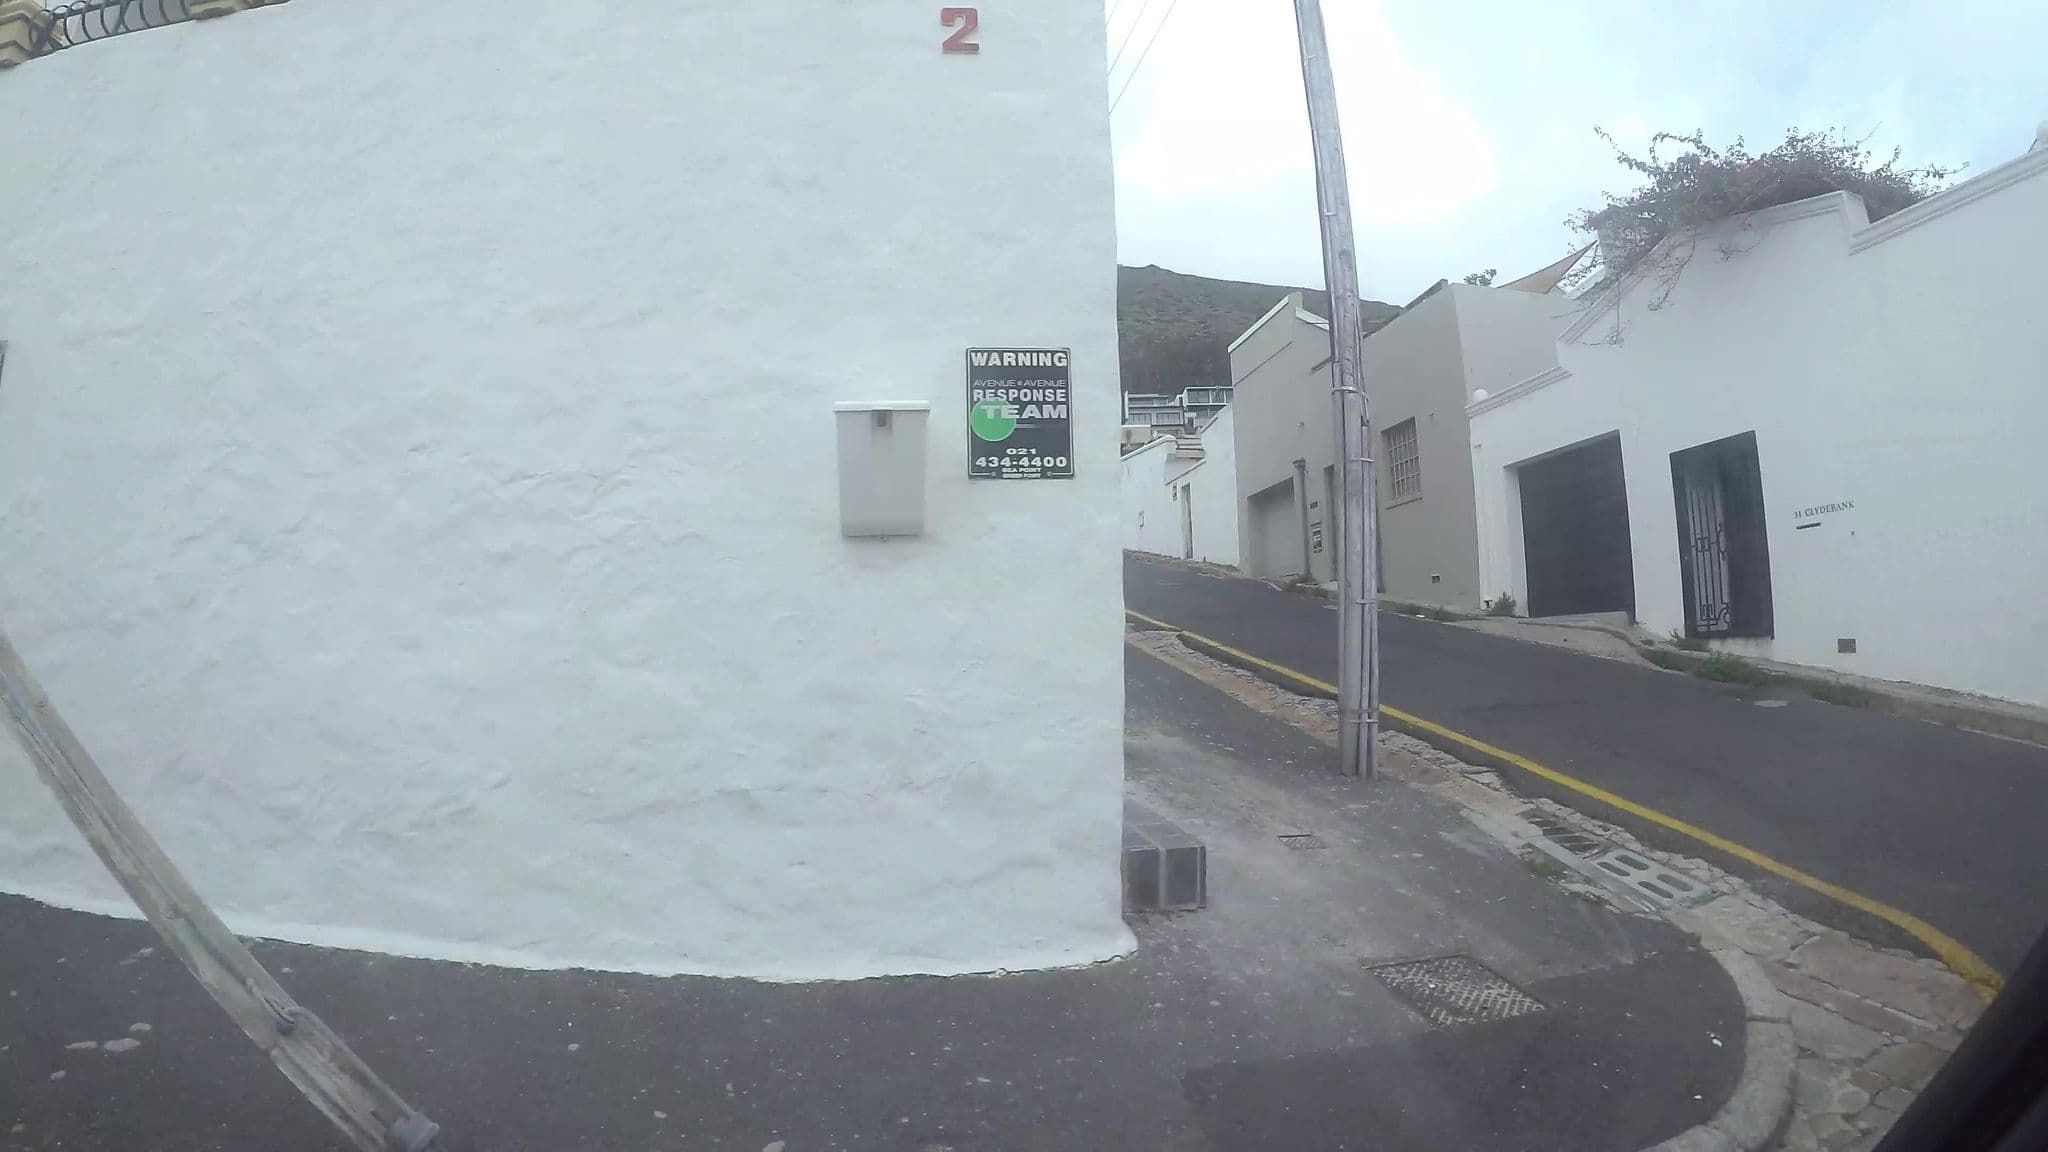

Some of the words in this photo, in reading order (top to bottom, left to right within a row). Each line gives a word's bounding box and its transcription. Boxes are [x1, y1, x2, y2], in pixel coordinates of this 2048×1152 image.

[941, 7, 979, 54] 2
[970, 352, 1067, 367] WARNING
[973, 379, 1018, 387] AVENUE
[1023, 379, 1066, 387] AVENUE
[973, 389, 1067, 402] RESPONSE
[980, 404, 1067, 419] TEAM
[975, 456, 1067, 468] 434-4400
[1804, 499, 1855, 517] CLYDEBANK
